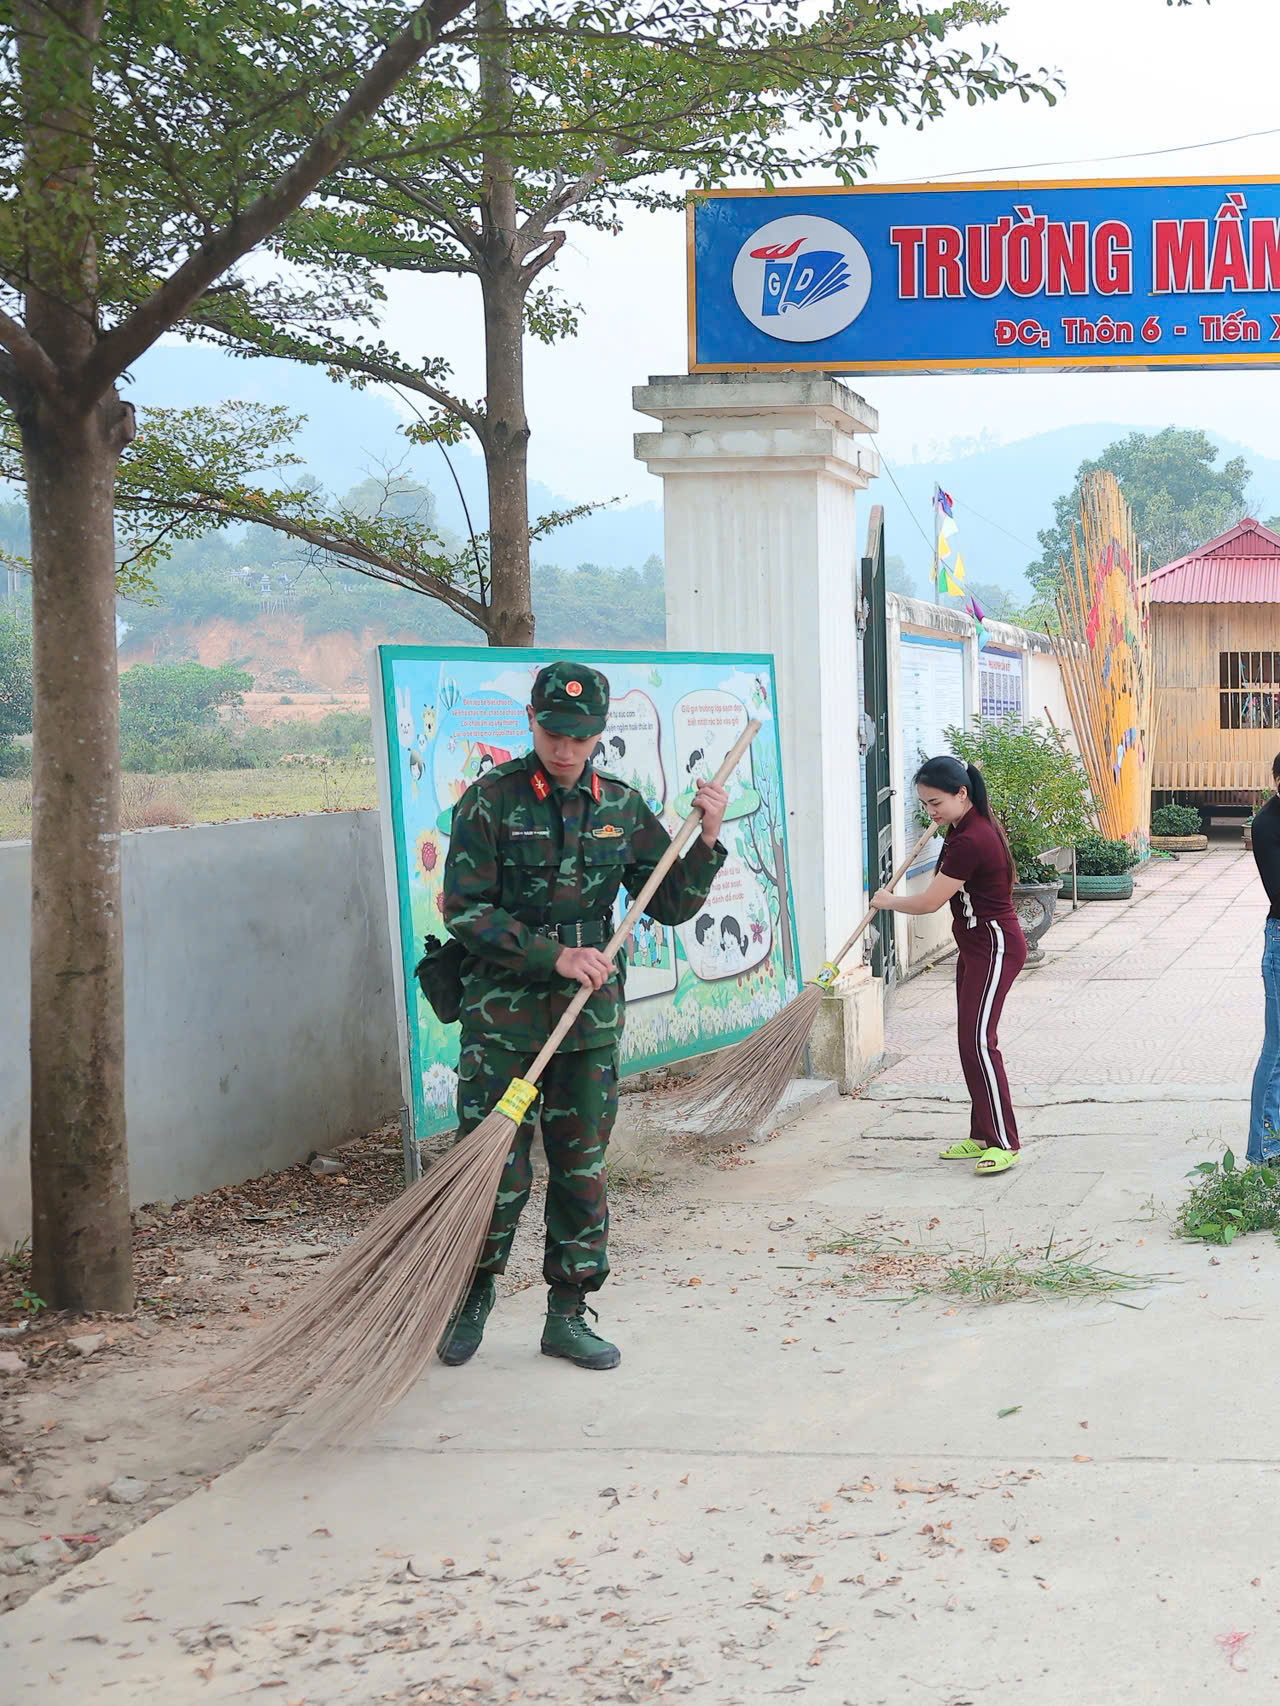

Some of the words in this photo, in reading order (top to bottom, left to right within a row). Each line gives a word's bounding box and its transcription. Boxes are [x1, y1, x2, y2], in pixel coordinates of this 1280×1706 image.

[891, 205, 1133, 299] TRƯỜNG
[1061, 315, 1134, 345] Thôn
[1141, 315, 1163, 344] 6
[1199, 309, 1260, 343] Tiến
